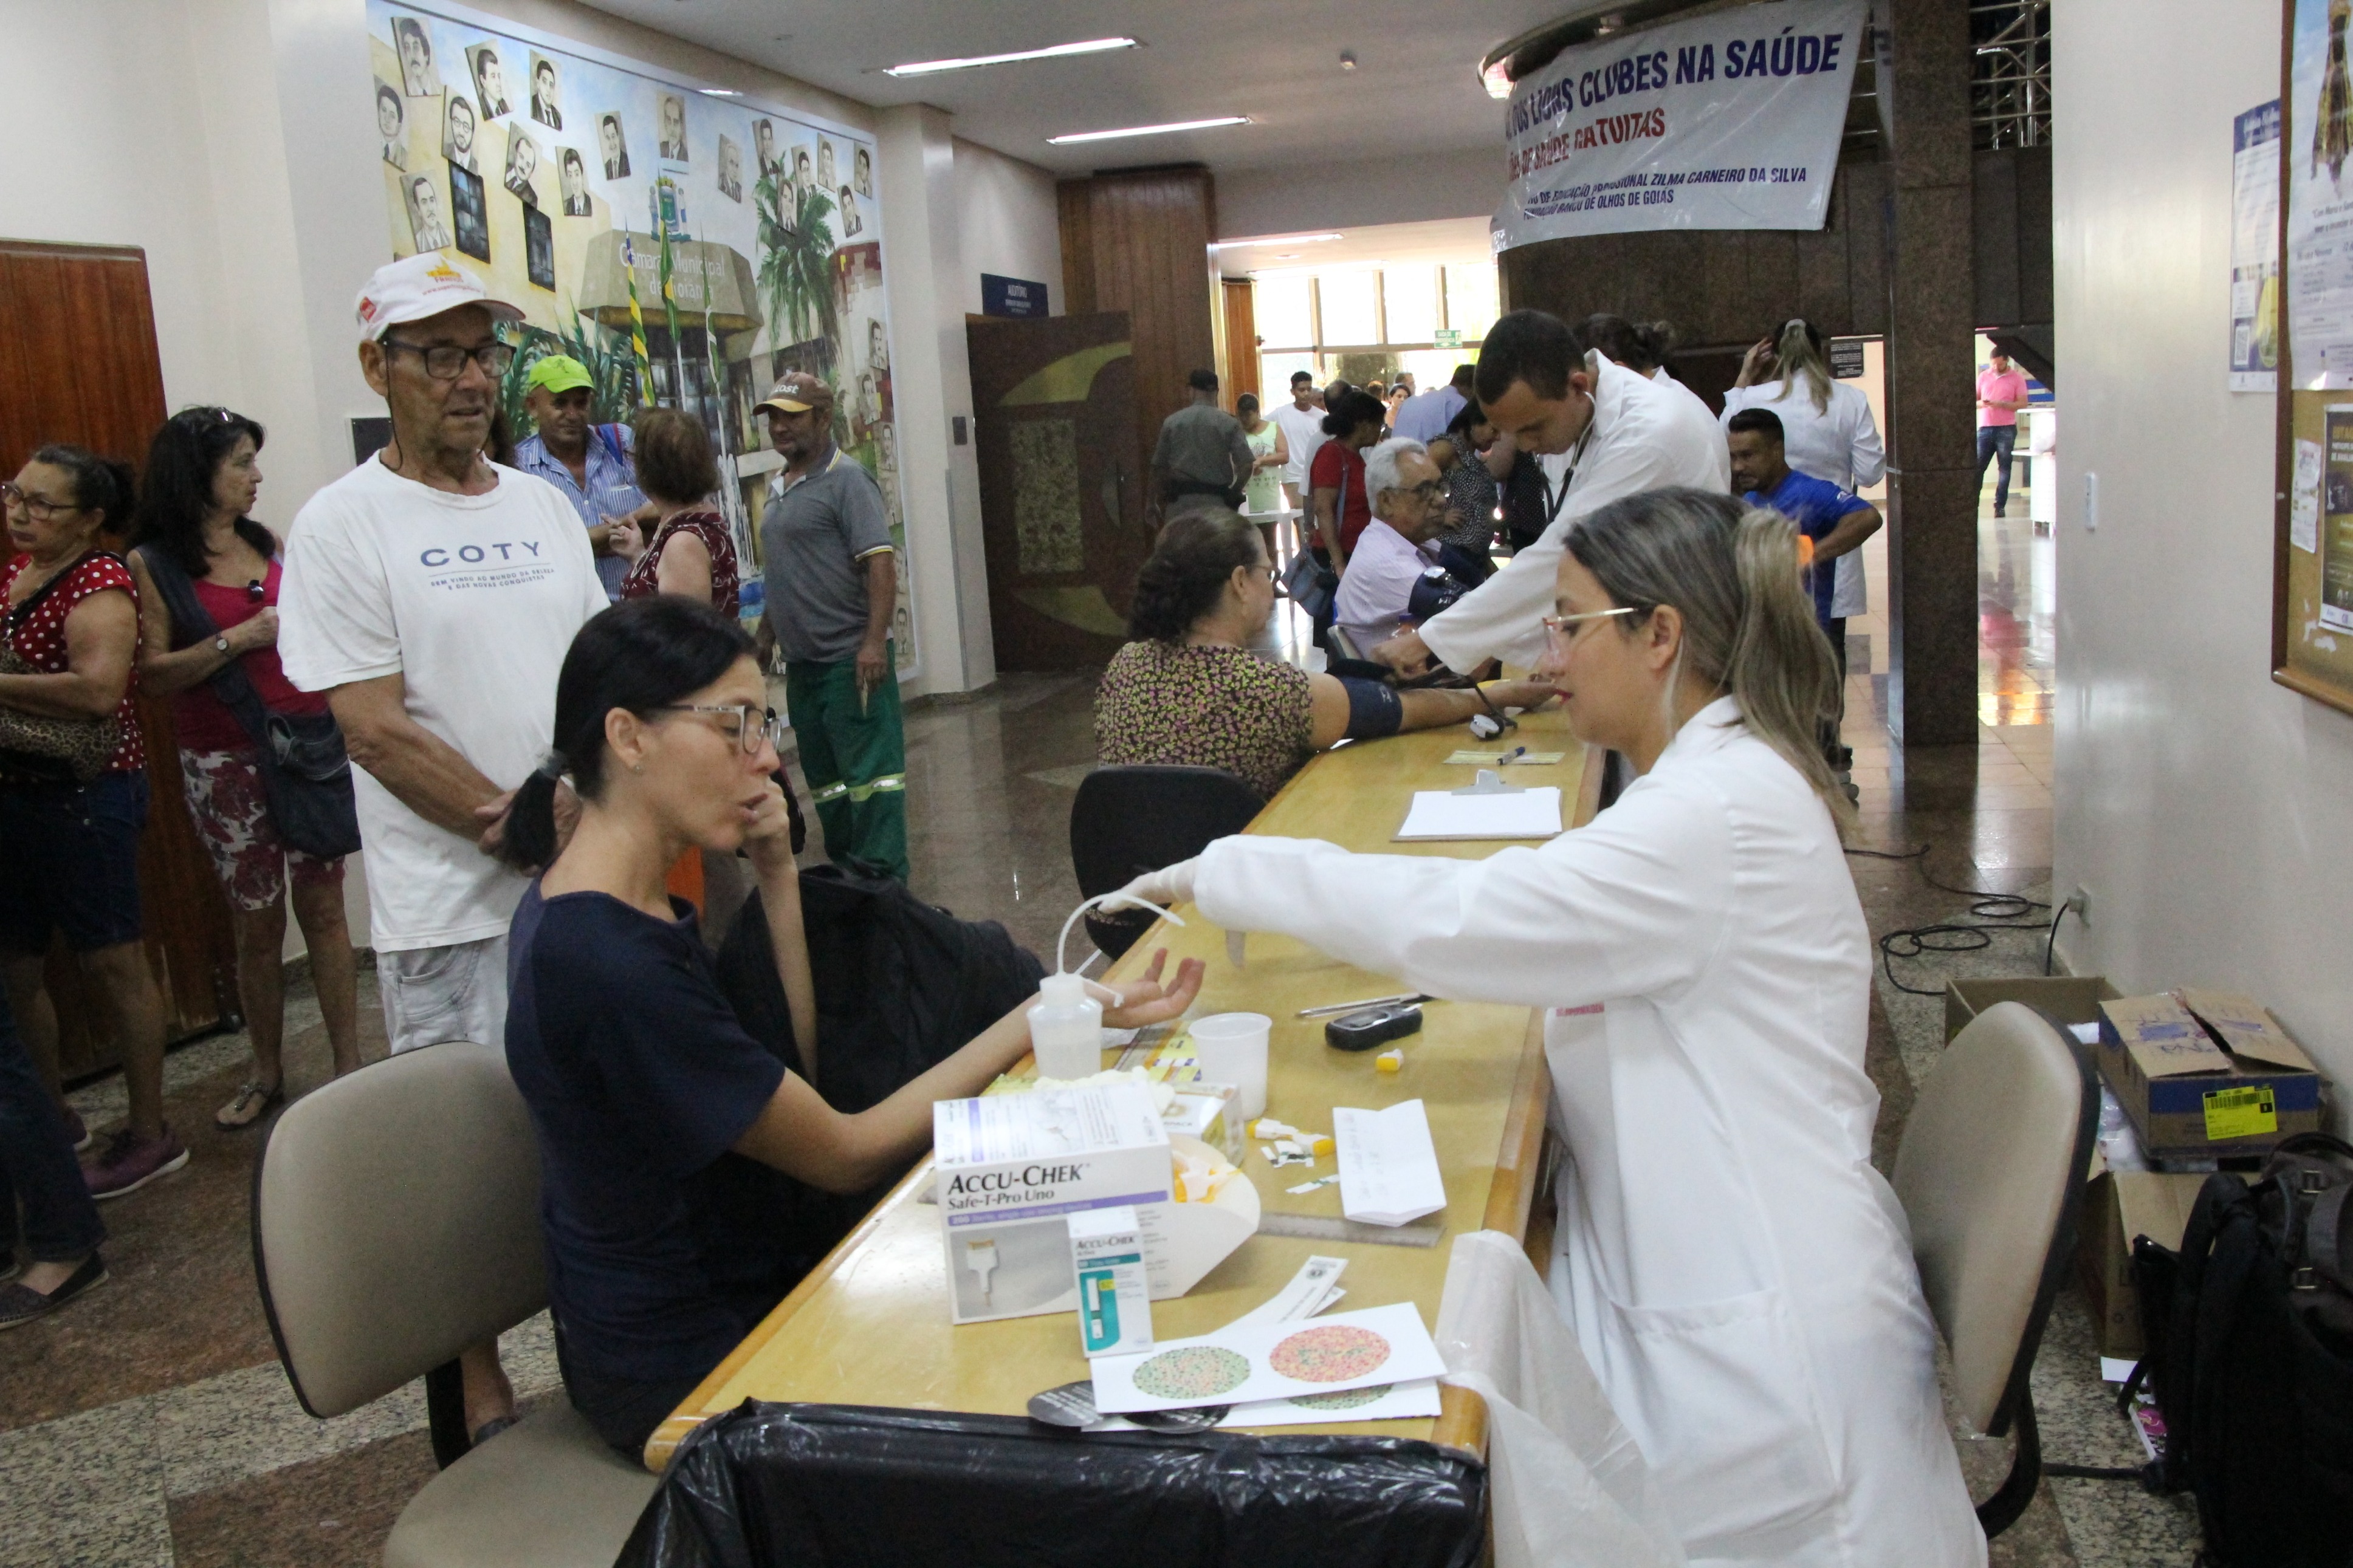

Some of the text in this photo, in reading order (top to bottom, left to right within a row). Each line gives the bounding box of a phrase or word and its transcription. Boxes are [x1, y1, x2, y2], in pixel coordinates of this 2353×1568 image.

[1580, 50, 1668, 108] CLUBES
[1675, 44, 1715, 84] NA
[1724, 26, 1844, 79] SAÚDE
[1651, 173, 1686, 187] ZILMA
[1687, 168, 1746, 184] CARNEIRO
[1749, 168, 1767, 182] DA
[1771, 167, 1807, 182] SILVA
[1584, 196, 1595, 210] DE
[1598, 192, 1625, 209] OLHOS
[1628, 191, 1640, 206] DE
[1643, 187, 1674, 205] GOIÁS
[421, 541, 540, 567] COTY
[450, 575, 475, 584] VINDO
[489, 572, 517, 581] MUNDO
[499, 575, 545, 587] CONQUISTAS
[947, 1163, 1085, 1196] ACCU-CHEK
[947, 1189, 1055, 1211] Safe-T-Pro Uno
